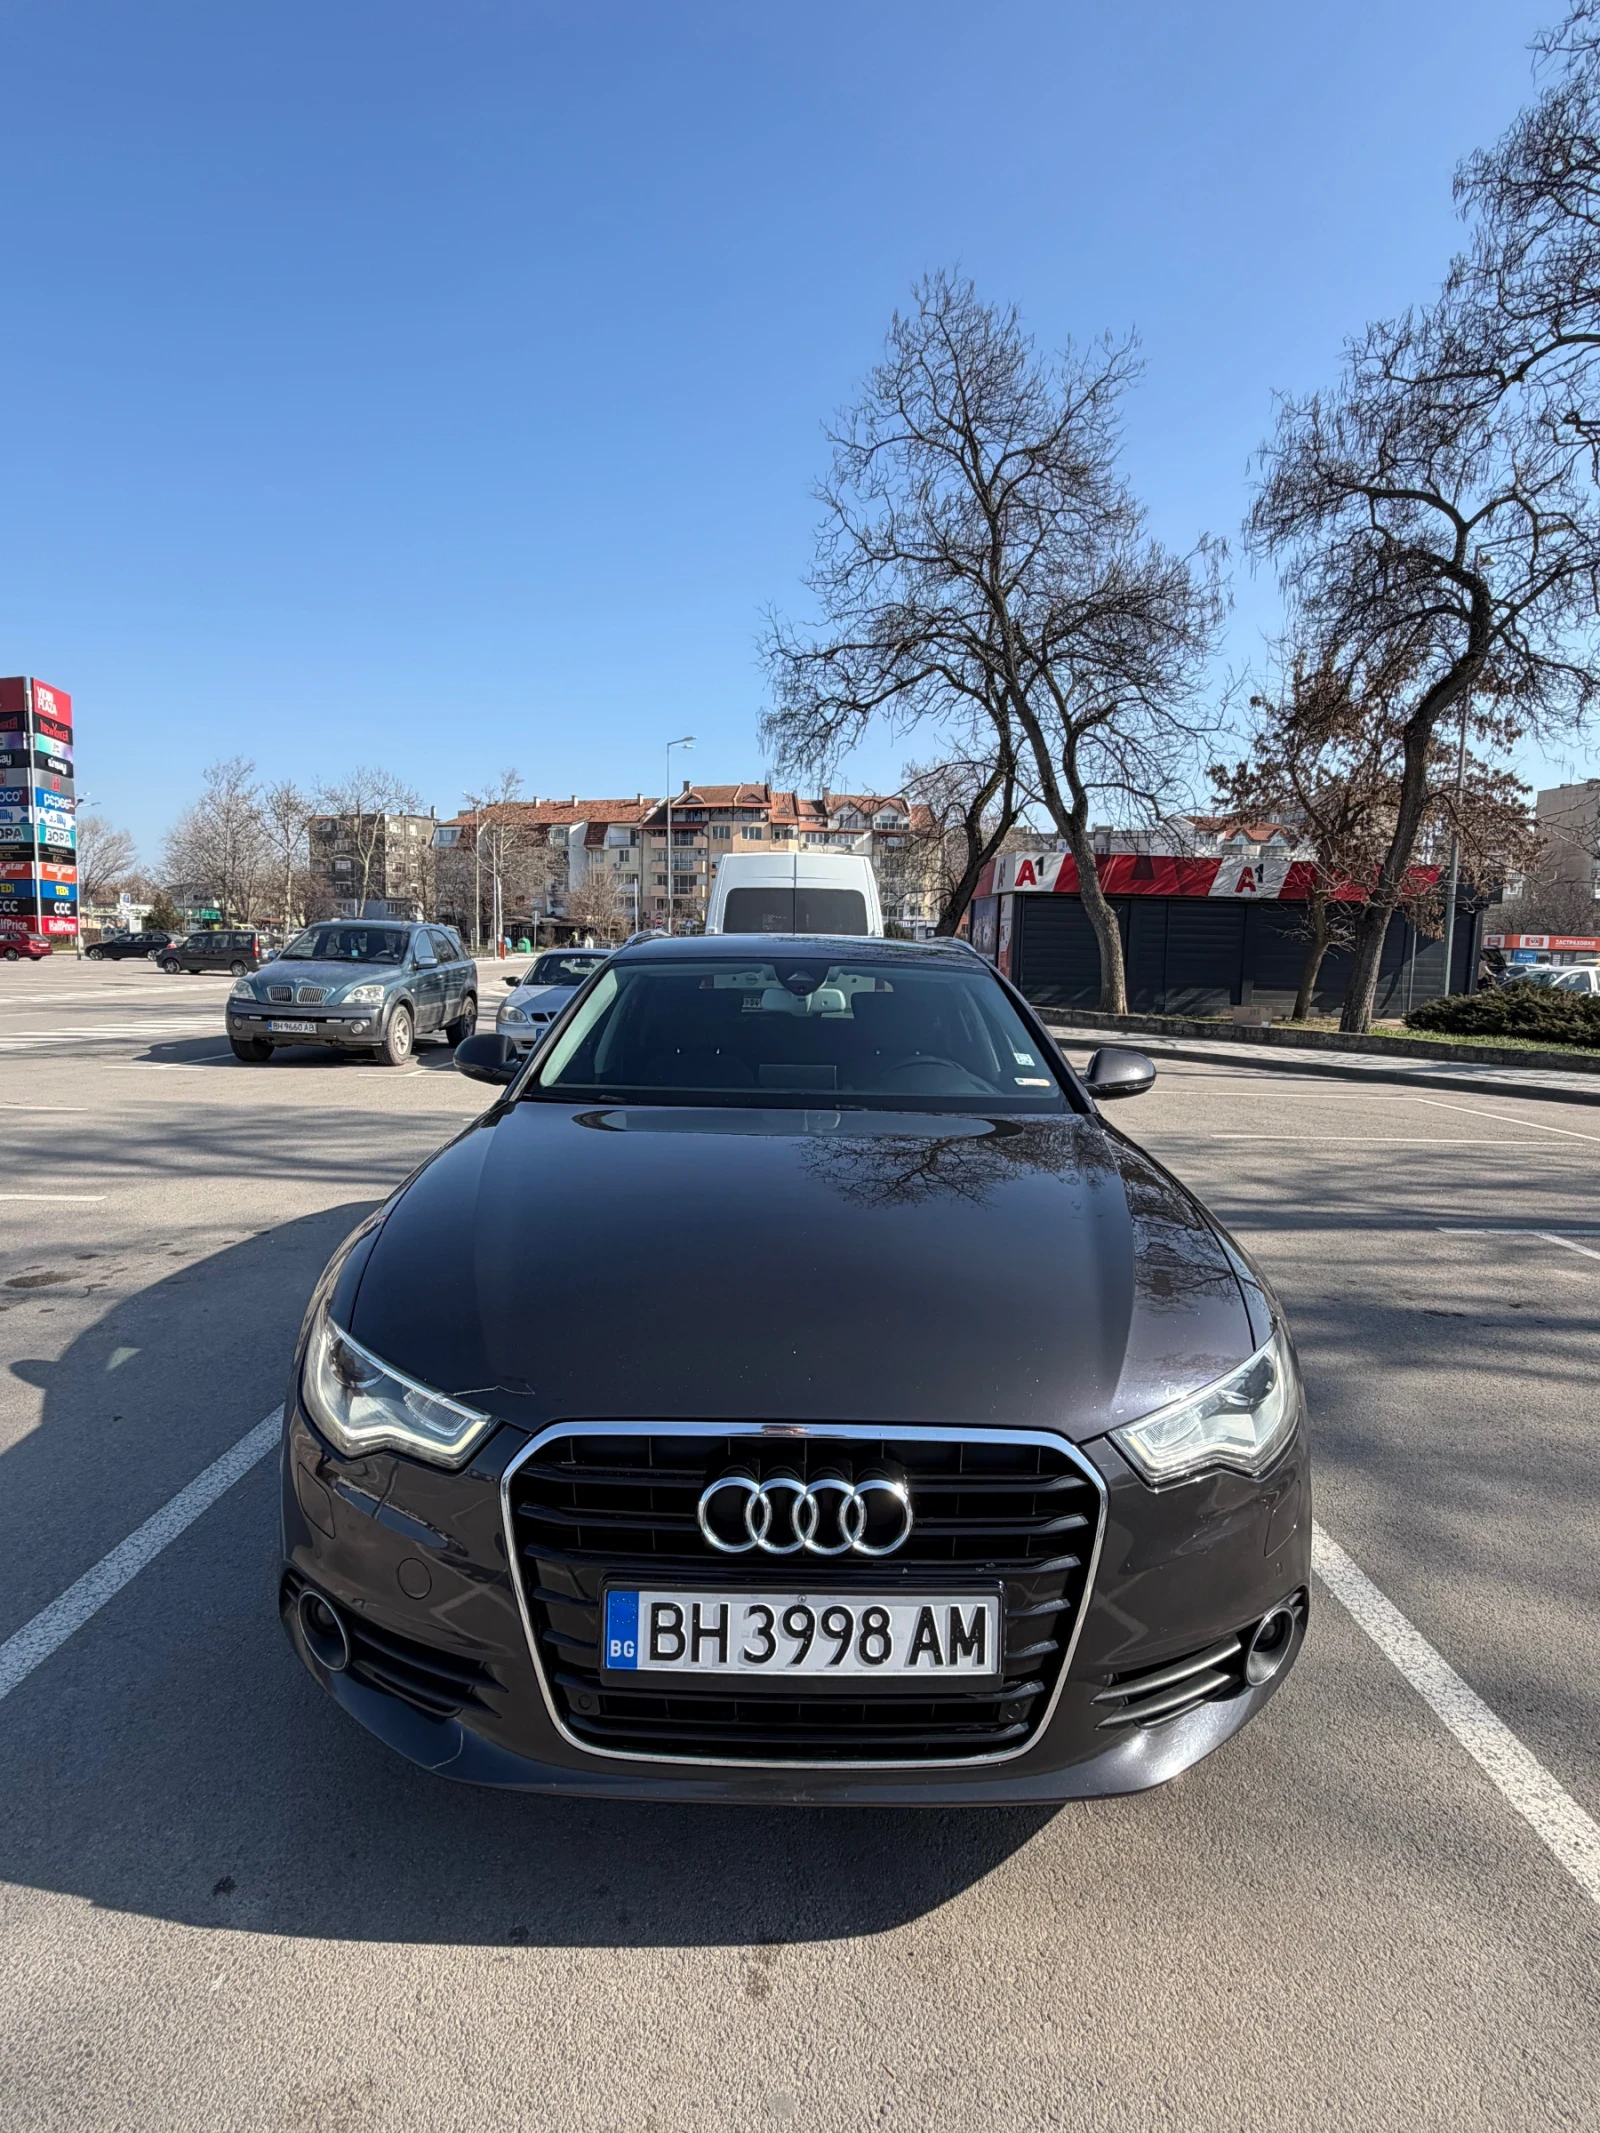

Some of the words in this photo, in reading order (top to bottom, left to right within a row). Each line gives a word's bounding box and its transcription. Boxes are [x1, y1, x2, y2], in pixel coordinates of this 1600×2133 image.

[1014, 856, 1045, 887] A1
[1234, 863, 1264, 893] A1
[53, 901, 71, 915] CCC
[284, 1022, 303, 1031] 9660
[648, 1601, 728, 1663] BH
[742, 1603, 894, 1667] 3998
[908, 1603, 987, 1667] AM
[609, 1640, 635, 1658] BG
